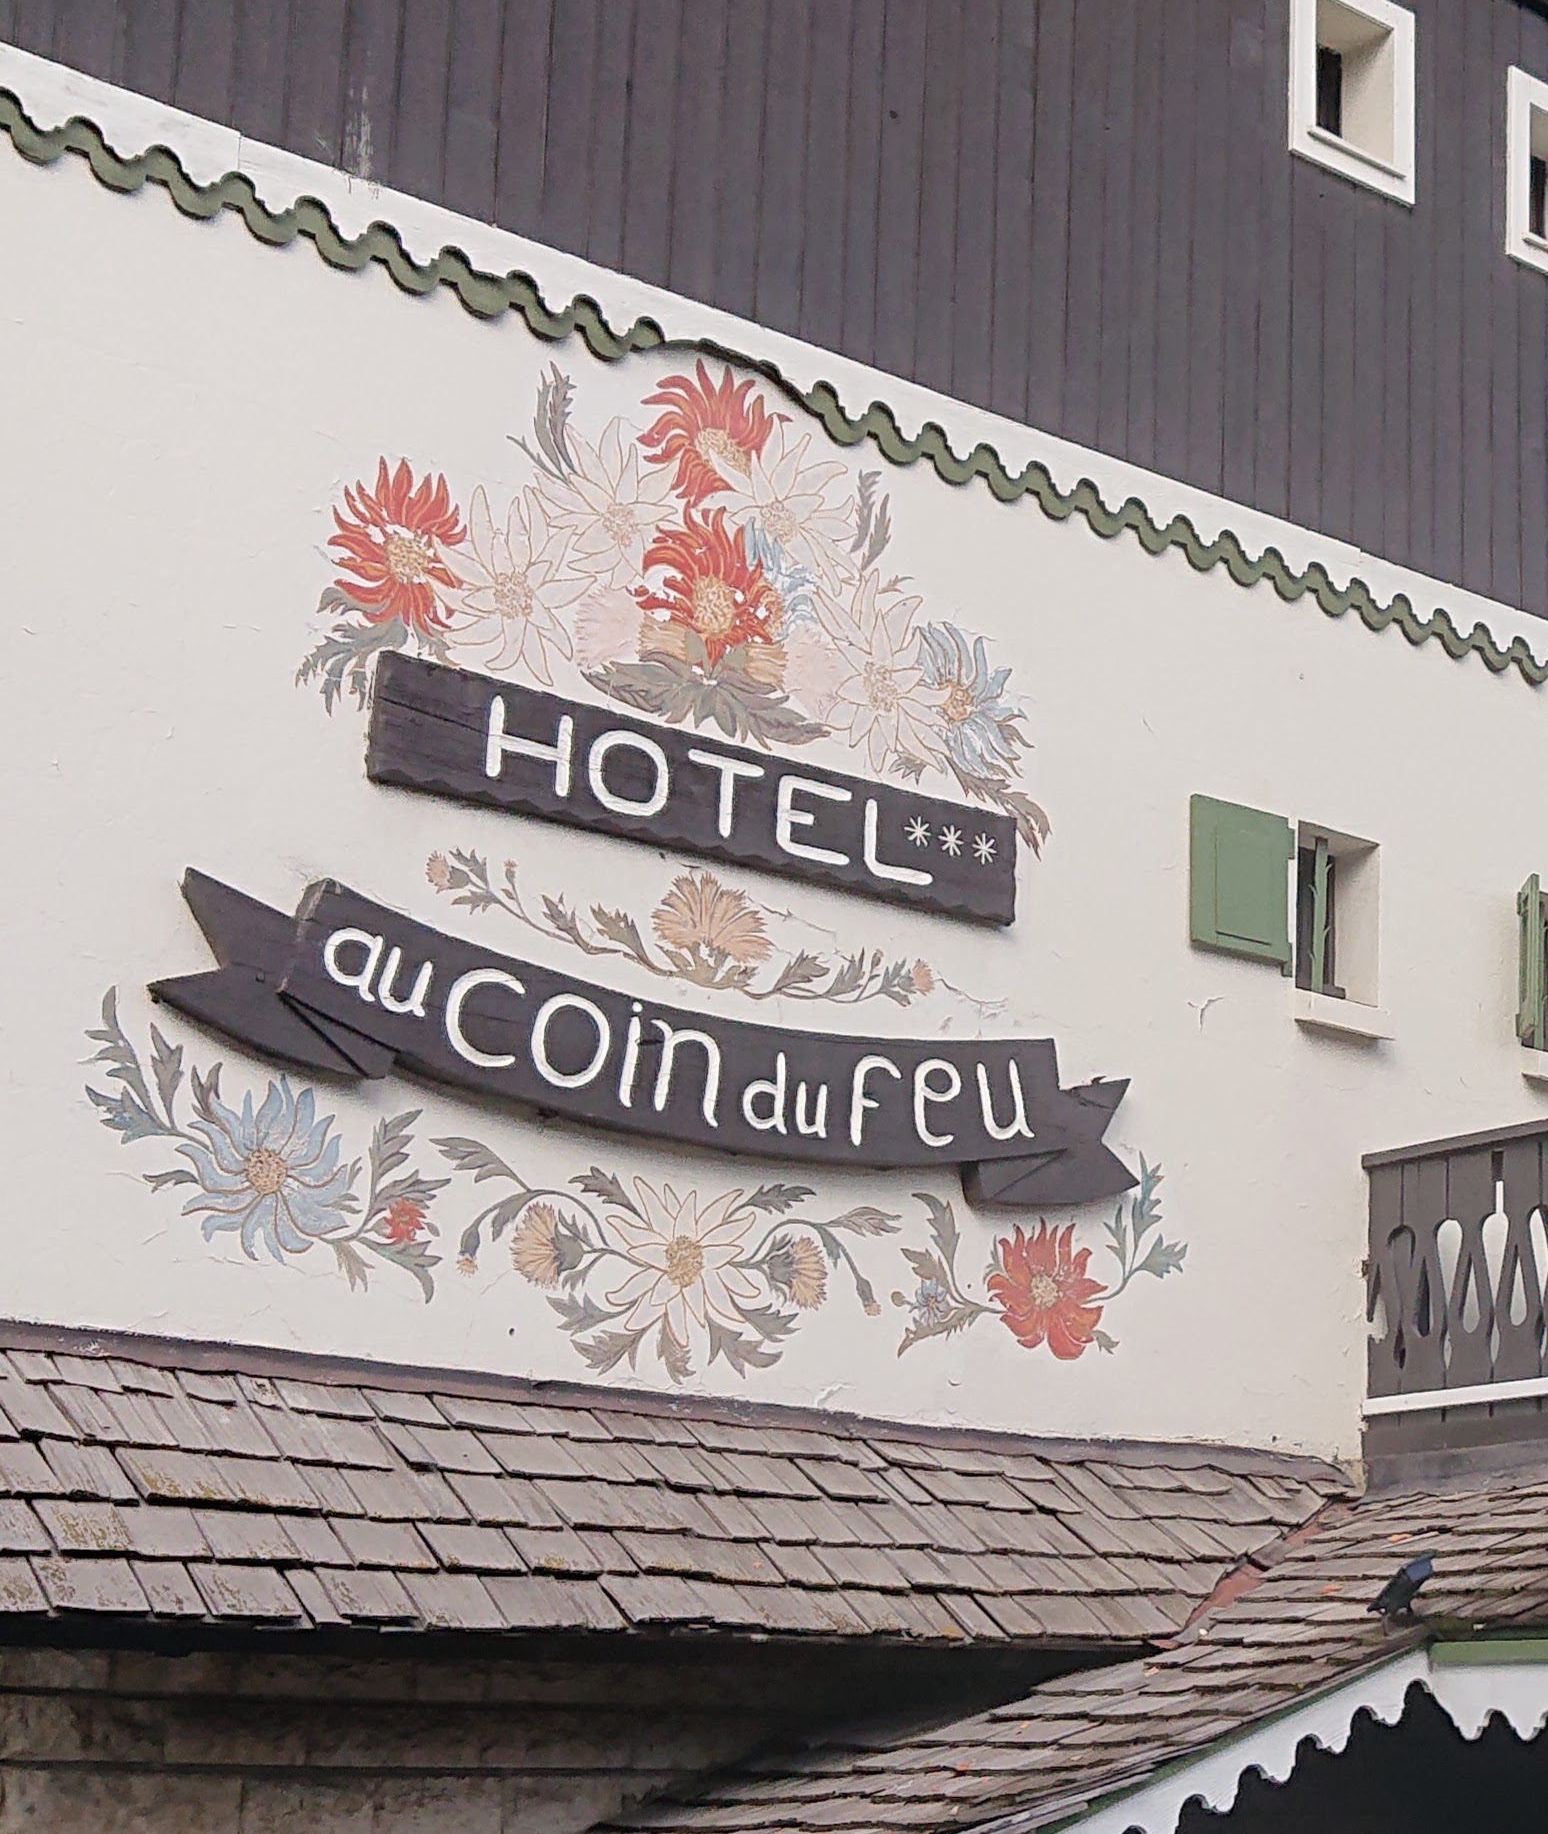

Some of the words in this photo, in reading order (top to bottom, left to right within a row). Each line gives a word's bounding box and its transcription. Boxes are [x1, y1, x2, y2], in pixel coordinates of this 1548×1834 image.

[484, 694, 934, 887] HOTEL
[322, 926, 434, 1018] au
[741, 1051, 829, 1140] du
[849, 1054, 1036, 1148] feu
